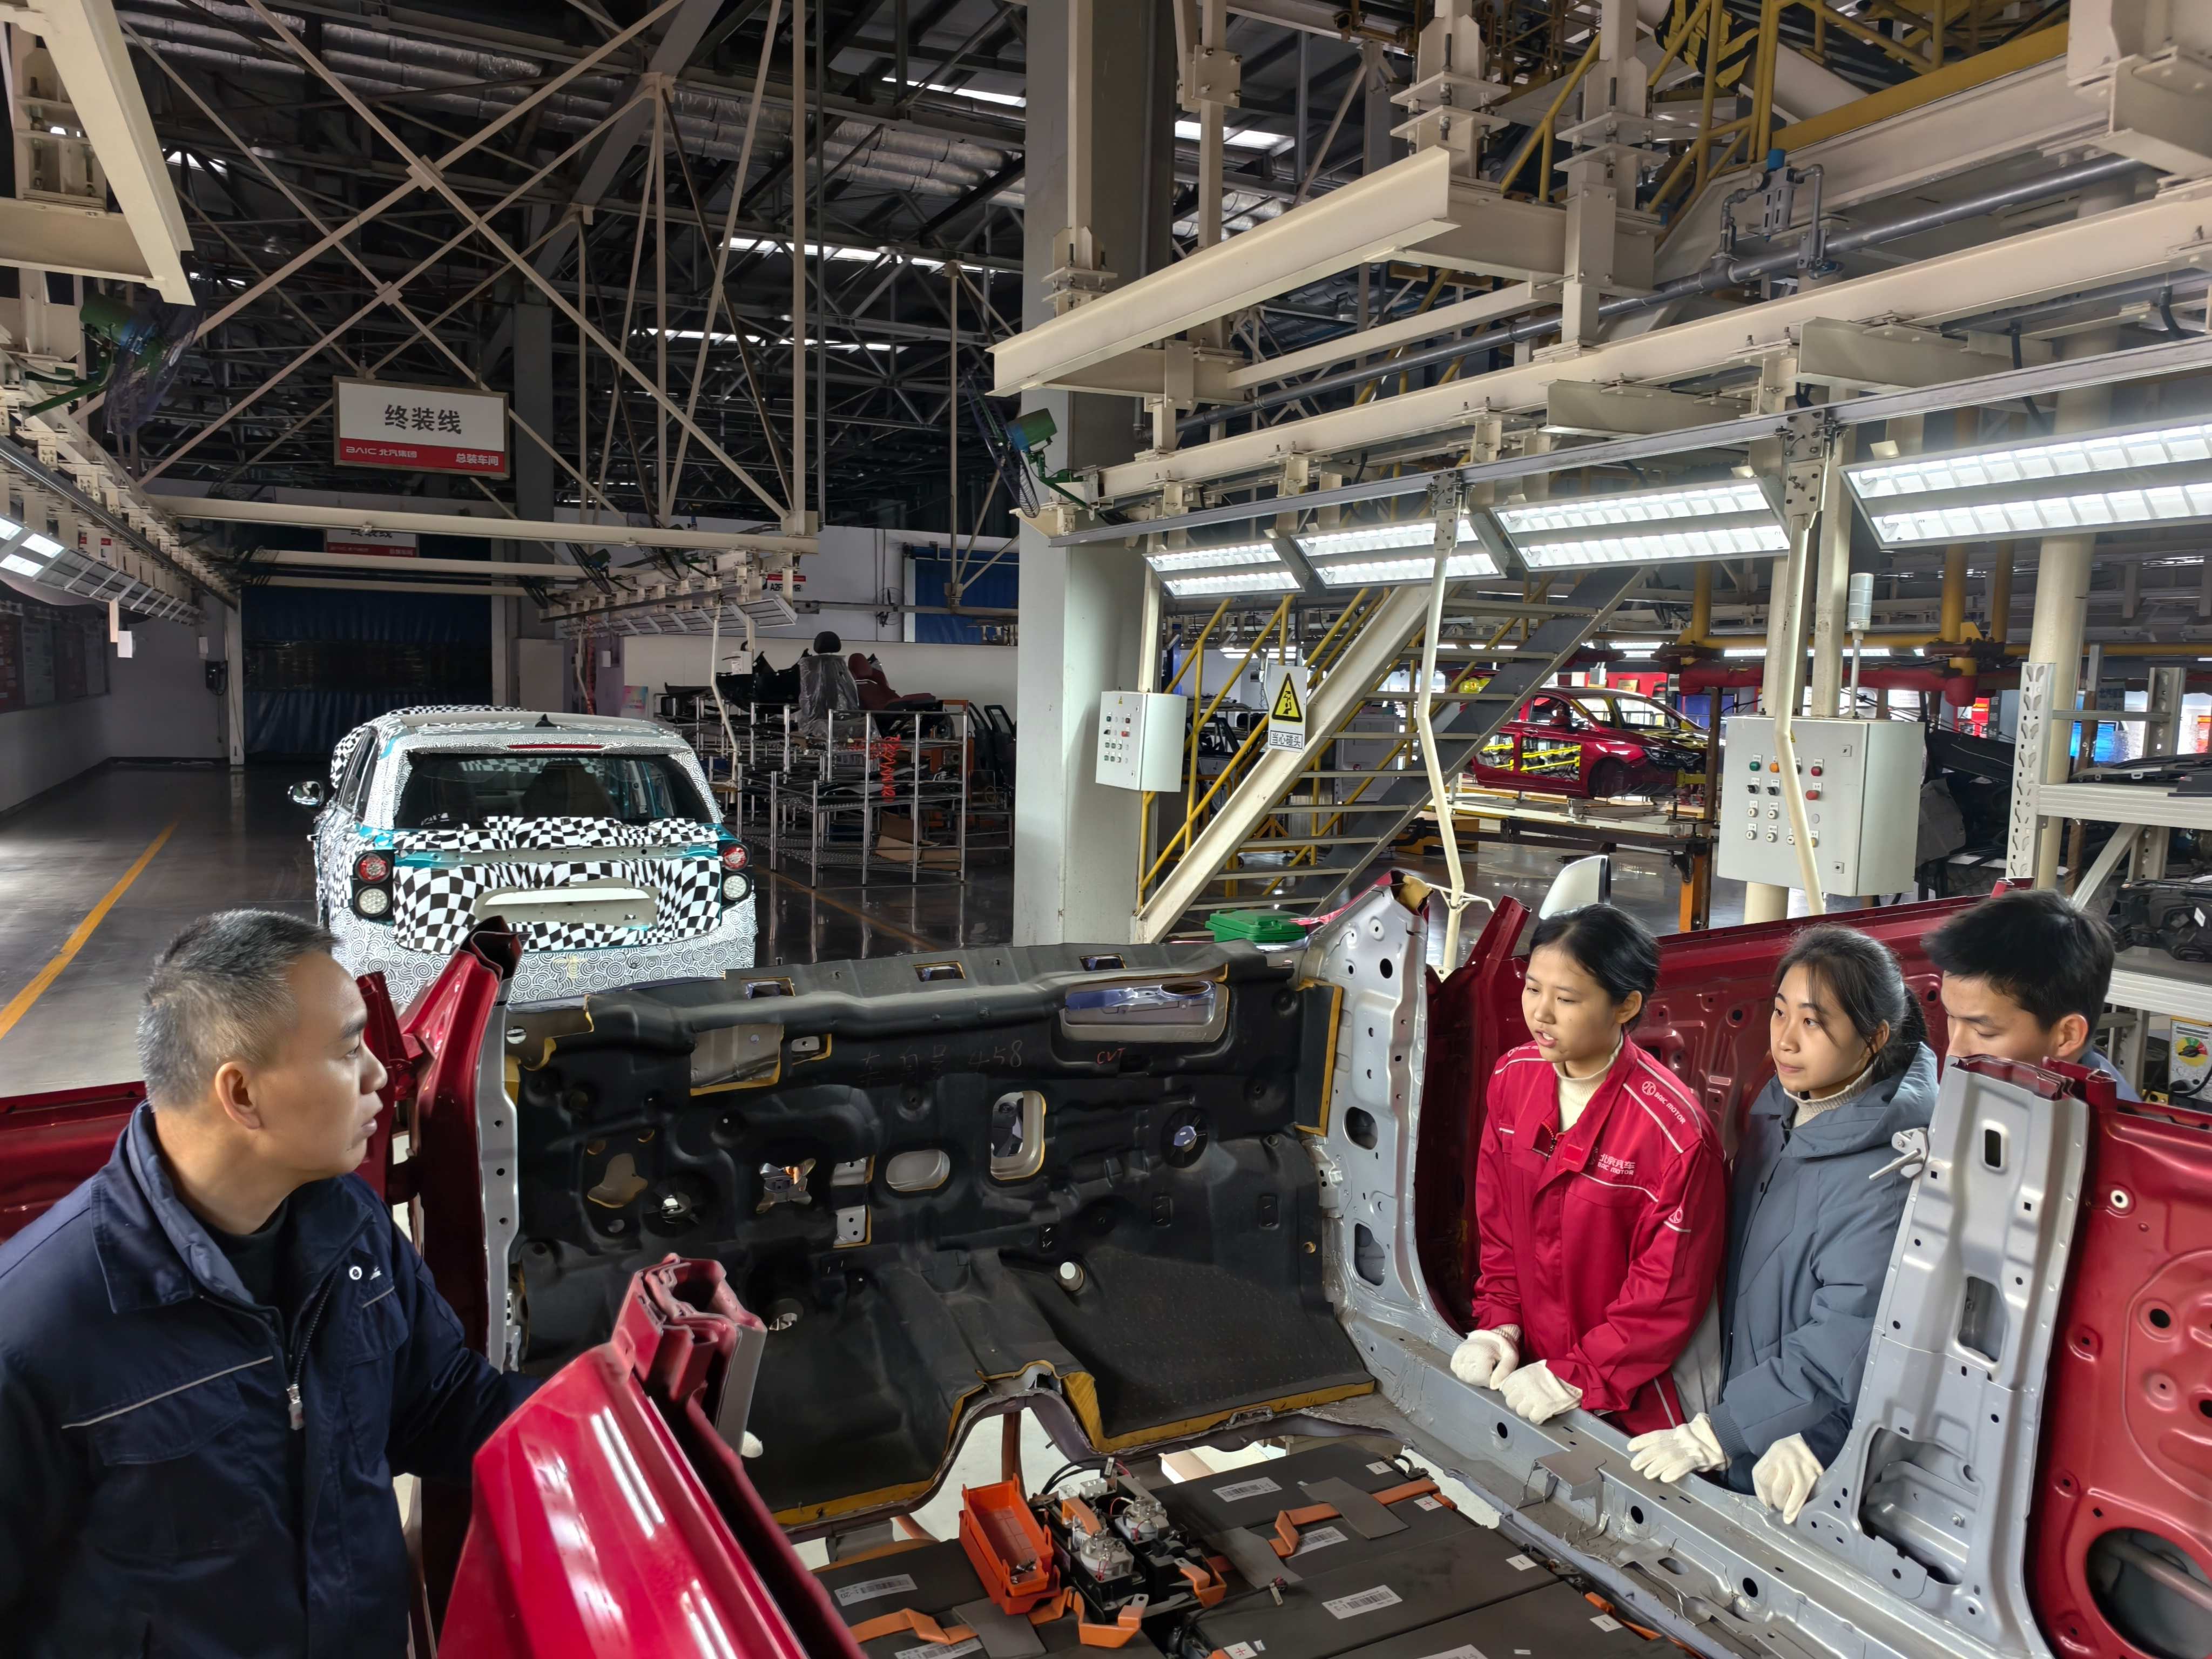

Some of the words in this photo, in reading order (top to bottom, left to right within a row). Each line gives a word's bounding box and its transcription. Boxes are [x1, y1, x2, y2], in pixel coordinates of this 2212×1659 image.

[385, 404, 461, 434] 终装线
[346, 446, 377, 455] BAIC
[379, 449, 417, 458] 北汽集团
[455, 453, 498, 466] 总装车间
[1271, 732, 1300, 747] 当心碰头
[968, 1040, 1023, 1073] 458
[1097, 1047, 1127, 1064] CVT
[1653, 1092, 1668, 1104] BAIC
[1666, 1103, 1686, 1124] MOTOR
[1597, 1162, 1609, 1170] BAIC
[1610, 1168, 1634, 1176] MOTOR
[1599, 1154, 1636, 1170] 北京汽车
